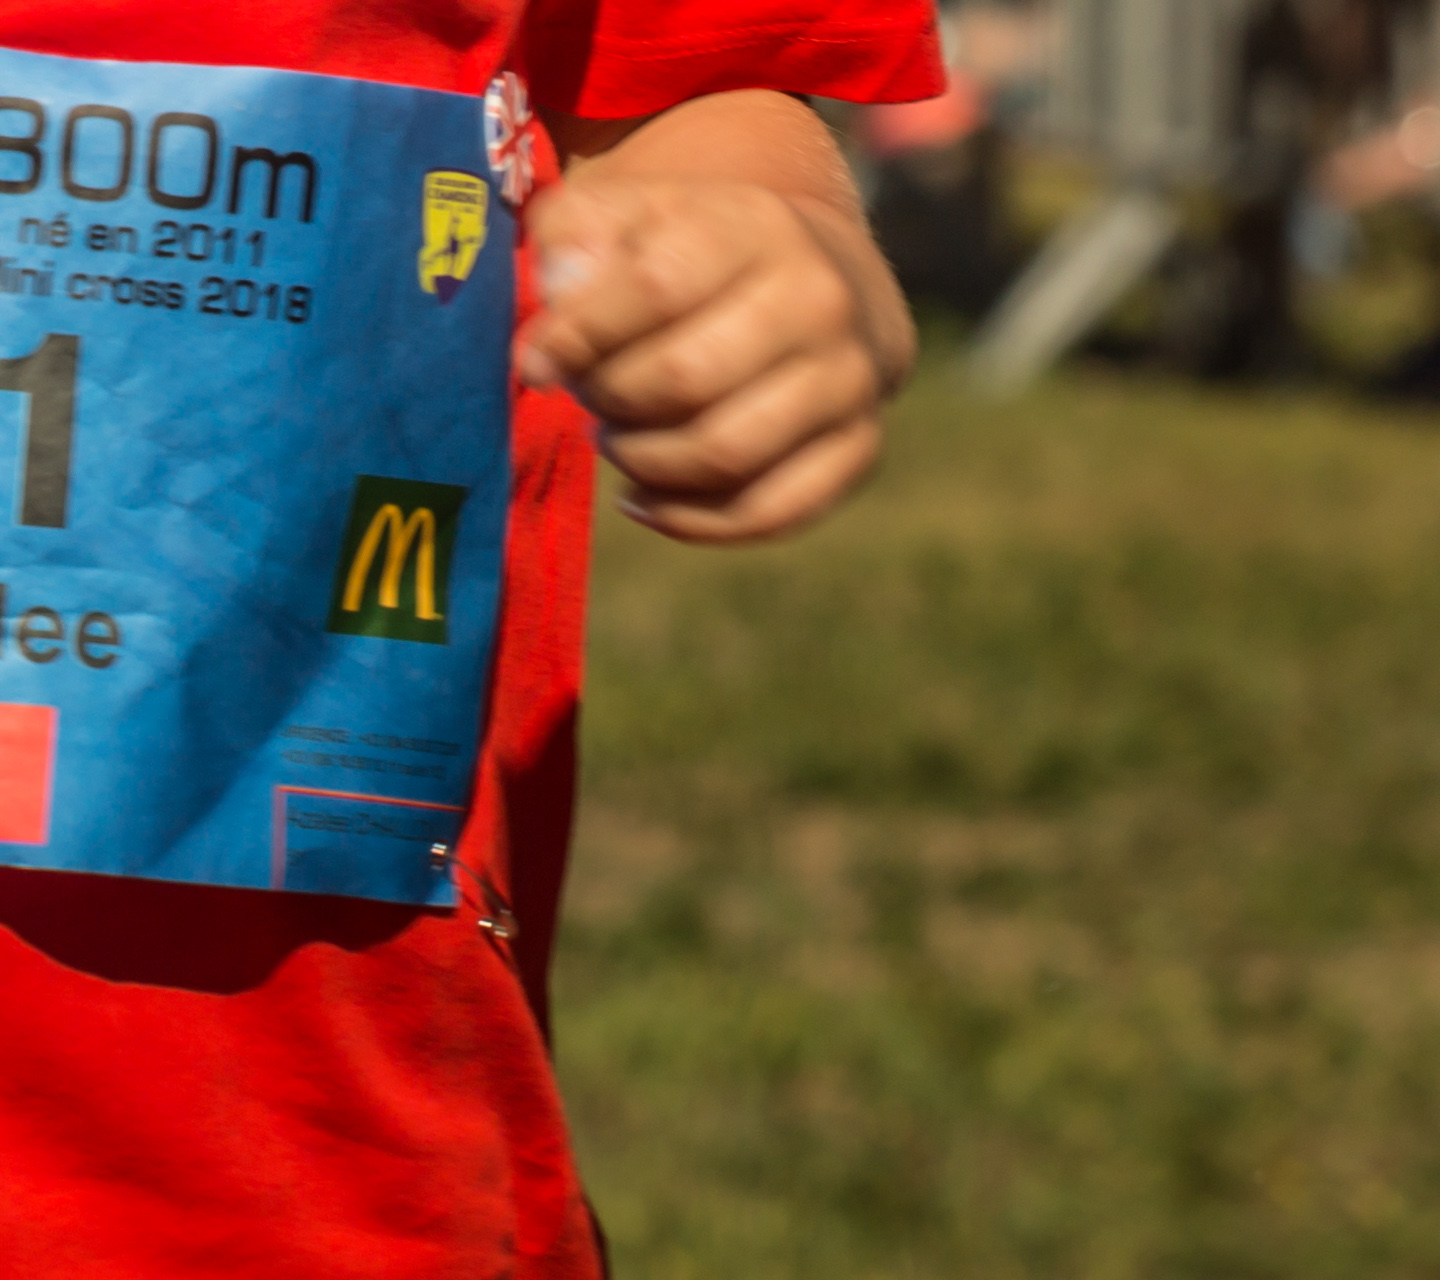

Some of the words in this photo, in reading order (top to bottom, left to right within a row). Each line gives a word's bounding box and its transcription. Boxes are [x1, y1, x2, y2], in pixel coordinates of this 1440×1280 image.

[18, 211, 71, 248] né
[86, 223, 138, 254] en
[152, 219, 266, 267] 2011
[66, 272, 187, 311] cross
